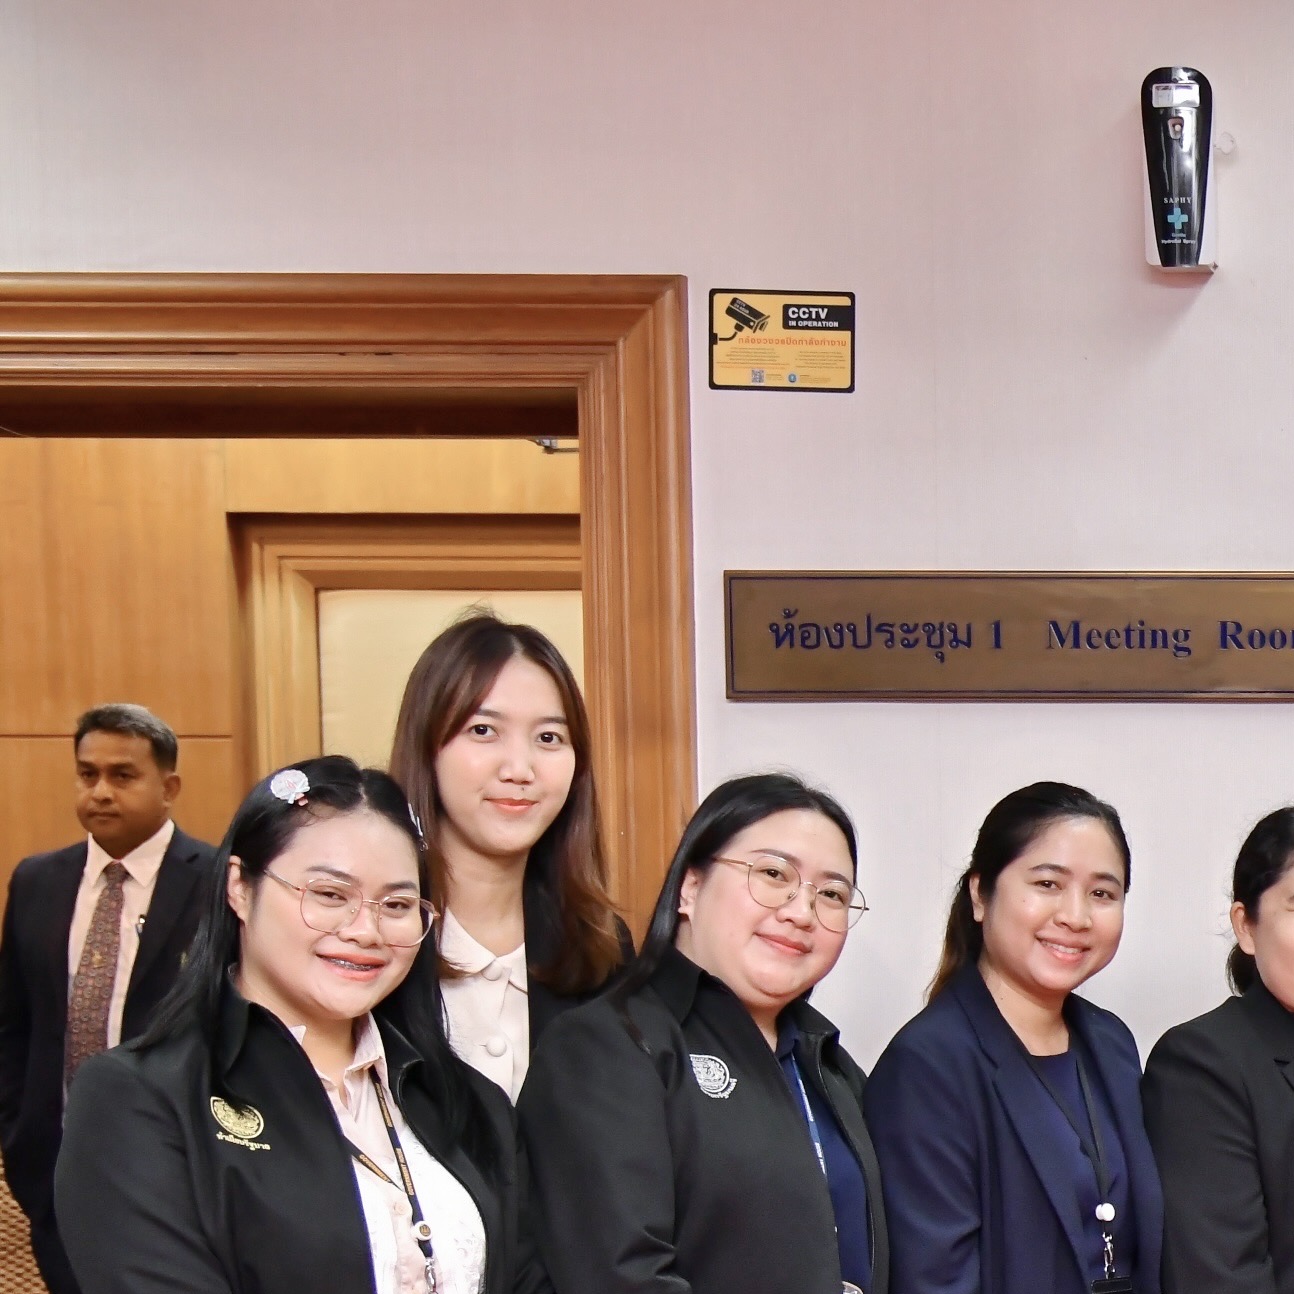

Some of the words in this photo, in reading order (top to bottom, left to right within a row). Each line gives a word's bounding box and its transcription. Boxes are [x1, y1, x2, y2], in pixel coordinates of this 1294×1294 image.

[788, 307, 828, 319] CCTV
[769, 608, 972, 664] ห้องประชุม
[991, 620, 1002, 650] 1
[1047, 620, 1192, 659] Meeting
